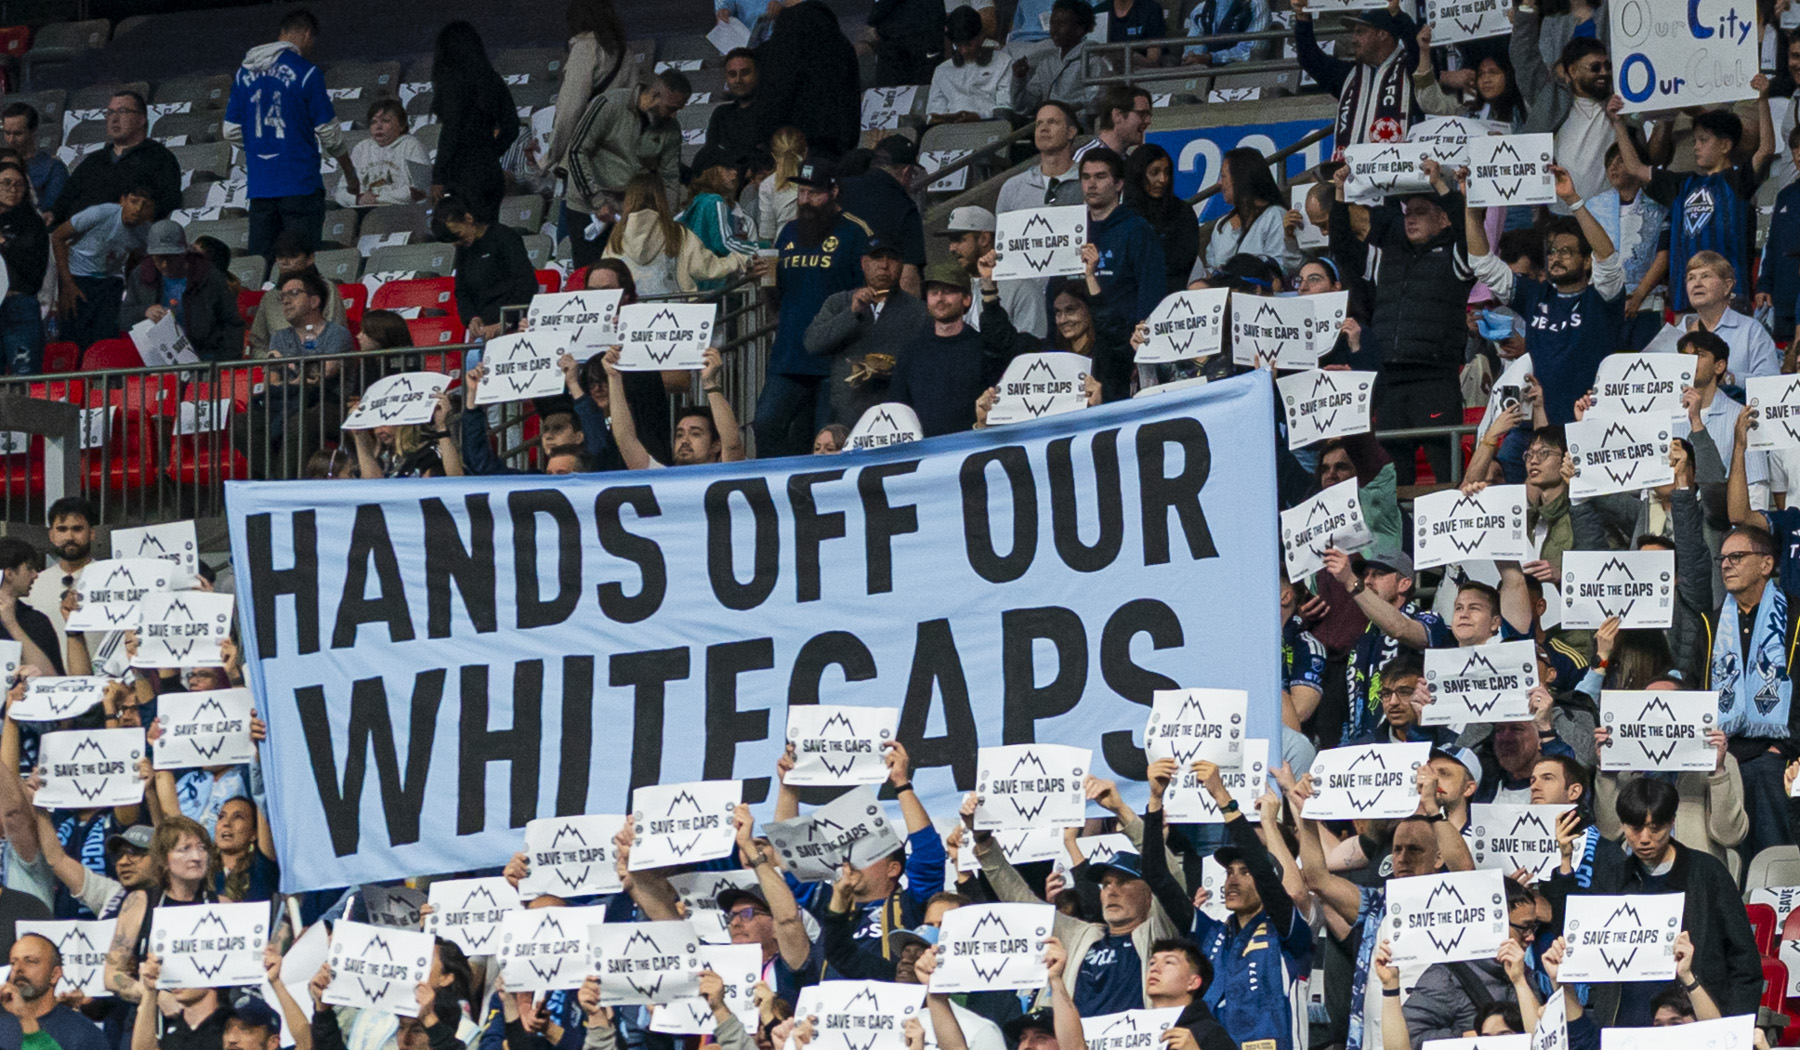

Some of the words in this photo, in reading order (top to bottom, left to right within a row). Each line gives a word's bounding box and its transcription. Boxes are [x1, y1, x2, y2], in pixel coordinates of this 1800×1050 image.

[1612, 0, 1686, 48] Our
[1687, 0, 1752, 46] City
[1618, 52, 1686, 104] Our
[250, 88, 287, 139] 14
[1476, 164, 1498, 178] SAVE
[1499, 165, 1511, 175] THE
[1512, 162, 1535, 176] CAPS
[1008, 237, 1029, 251] SAVE
[1031, 238, 1043, 247] THE
[1045, 234, 1068, 248] CAPS
[783, 255, 832, 269] TELUS
[1007, 382, 1030, 395] SAVE
[1032, 383, 1045, 392] THE
[1047, 381, 1071, 393] CAPS
[1604, 382, 1629, 396] SAVE
[1631, 383, 1644, 392] THE
[1647, 381, 1673, 393] CAPS
[1586, 449, 1611, 465] SAVE
[1611, 448, 1626, 459] THE
[1627, 443, 1653, 459] CAPS
[1432, 519, 1456, 535] SAVE
[1459, 518, 1473, 528] THE
[1476, 515, 1505, 528] CAPS
[245, 484, 667, 660] HANDS
[703, 458, 924, 611] OFF
[959, 416, 1220, 583] OUR
[1580, 583, 1604, 596] SAVE
[1606, 584, 1622, 595] THE
[1624, 582, 1652, 596] CAPS
[294, 597, 1185, 858] WHITECAPS
[1619, 723, 1646, 737] SAVE
[1648, 725, 1663, 736] THE
[1665, 724, 1694, 738] CAPS
[54, 763, 79, 777] SAVE
[81, 764, 95, 773] THE
[97, 761, 124, 774] CAPS
[992, 779, 1018, 794] SAVE
[1020, 780, 1034, 791] THE
[1036, 778, 1064, 792] CAPS
[1408, 911, 1435, 928] SAVE
[1437, 911, 1452, 923] THE
[1454, 907, 1484, 923] CAPS
[1582, 930, 1610, 944] SAVE
[1613, 931, 1627, 942] THE
[1629, 929, 1658, 943] CAPS
[953, 940, 979, 955] SAVE
[982, 941, 996, 952] THE
[1000, 938, 1027, 953] CAPS
